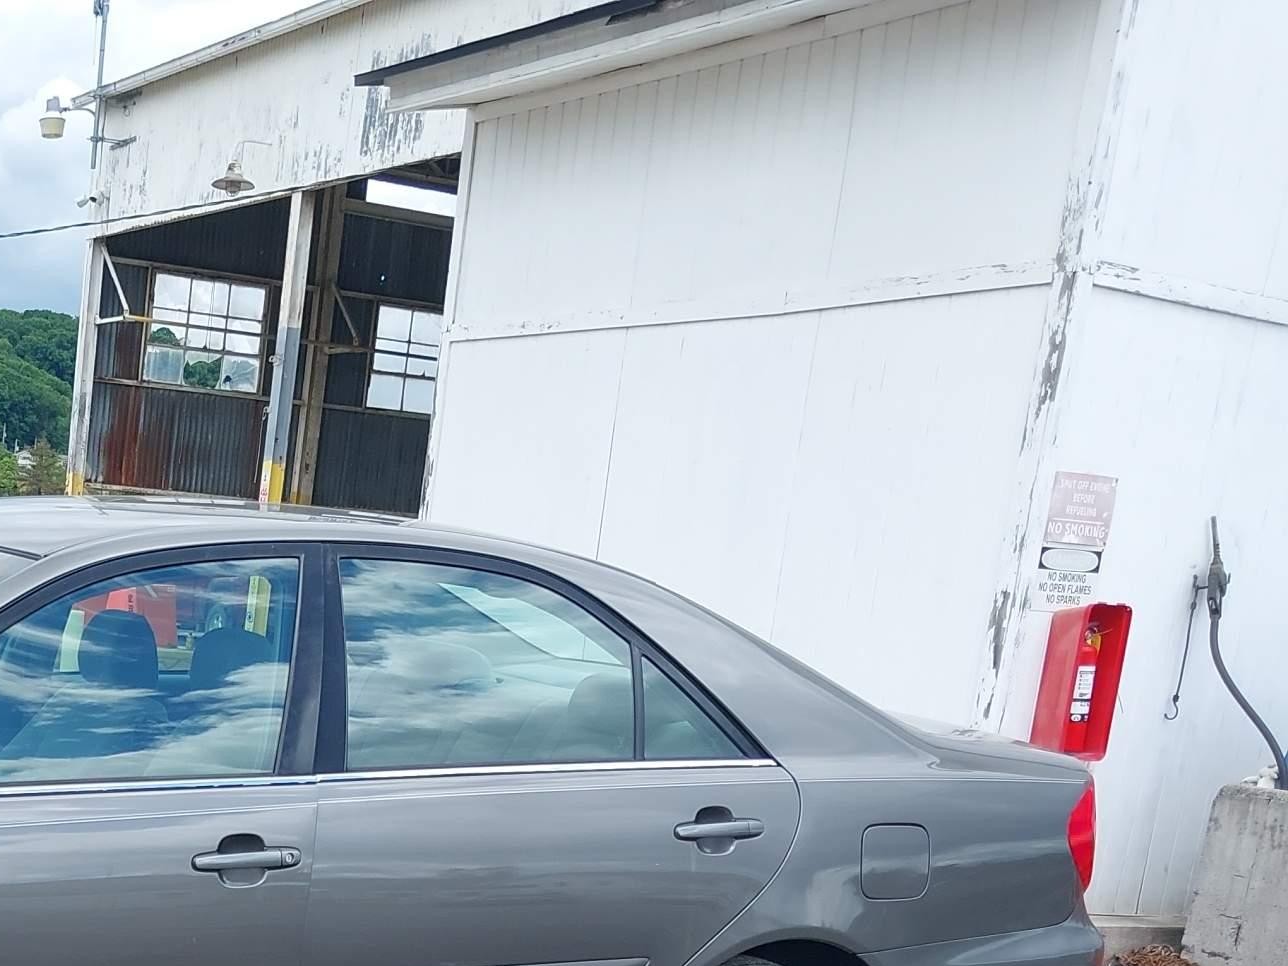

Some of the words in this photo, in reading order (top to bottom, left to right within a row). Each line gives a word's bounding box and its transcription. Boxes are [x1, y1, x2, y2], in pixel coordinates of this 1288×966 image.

[1048, 521, 1063, 535] NO
[1064, 522, 1105, 539] SMOKING
[1047, 571, 1057, 582] NO
[1058, 572, 1087, 584] SMOKING
[1038, 582, 1048, 592] NO
[1049, 583, 1066, 594] OPEN
[1067, 584, 1092, 595] FLAMES
[1046, 593, 1056, 604] NO
[1056, 595, 1081, 606] SPARKS
